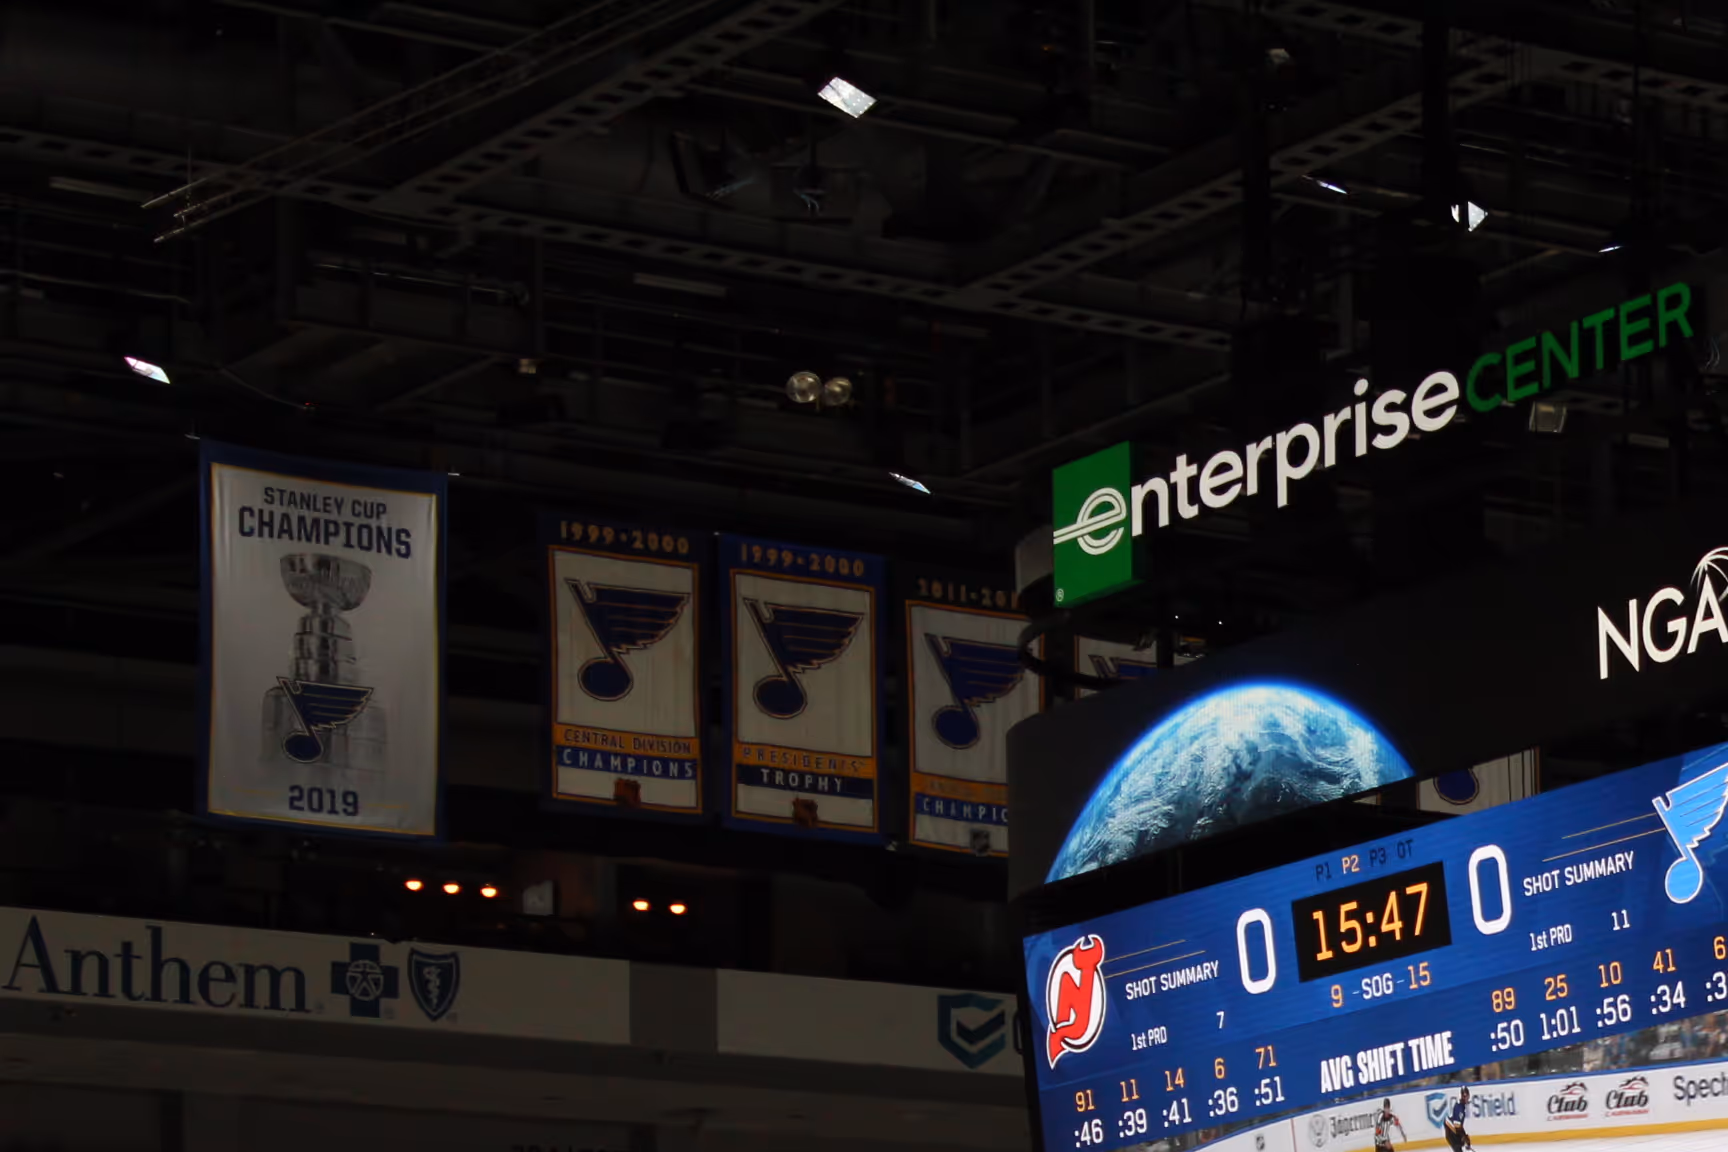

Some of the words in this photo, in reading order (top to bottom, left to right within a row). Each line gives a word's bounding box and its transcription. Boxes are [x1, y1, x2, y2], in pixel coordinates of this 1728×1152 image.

[1053, 369, 1460, 555] enterprise
[1464, 281, 1696, 413] CENTER
[264, 487, 344, 515] STANLEY
[351, 499, 387, 520] CUP
[238, 506, 412, 558] CHAMPIONS
[562, 749, 694, 778] CHAMPIONS
[563, 728, 625, 750] CENTRAL
[632, 736, 692, 755] DIVISION
[288, 785, 360, 816] 2019
[760, 767, 844, 792] TROPHY
[1315, 862, 1332, 881] P1
[1342, 855, 1360, 874] P2
[1369, 848, 1387, 867] P3
[1523, 868, 1561, 897] SHOT
[1564, 850, 1635, 888] SUMMARY
[1467, 843, 1512, 935] 0
[1312, 882, 1428, 961] 15:47
[1529, 930, 1548, 952] 1st
[1549, 923, 1573, 947] PRD
[1610, 909, 1631, 931] 11
[2, 915, 313, 1014] Anthem
[1235, 907, 1277, 995] 0
[1125, 976, 1157, 1001] SHOT
[1160, 959, 1220, 991] SUMMARY
[1330, 984, 1343, 1008] 9
[1407, 961, 1431, 990] 15
[1492, 987, 1516, 1013] 89
[1543, 974, 1569, 1001] 25
[1598, 961, 1623, 988] 10
[1652, 948, 1676, 974] 41
[1713, 935, 1726, 960] 6
[1131, 1029, 1147, 1051] 1st
[1148, 1025, 1168, 1047] PRD
[1215, 1011, 1225, 1030] 7
[1489, 1019, 1525, 1053] :50
[1541, 1006, 1581, 1040] 1:01
[1596, 994, 1632, 1028] :56
[1650, 981, 1686, 1016] :34
[1075, 1089, 1095, 1113] 91
[1120, 1079, 1140, 1103] 11
[1164, 1067, 1185, 1092] 14
[1214, 1058, 1225, 1080] 6
[1255, 1045, 1277, 1069] 71
[1320, 1055, 1355, 1094] AVG
[1356, 1040, 1406, 1086] SHIFT
[1408, 1030, 1456, 1072] TIME
[1074, 1119, 1103, 1148] :46
[1118, 1108, 1147, 1139] :39
[1162, 1098, 1192, 1129] :41
[1207, 1086, 1239, 1117] :36
[1254, 1076, 1285, 1107] :51
[1547, 1095, 1588, 1114] Club
[1606, 1090, 1649, 1109] Club
